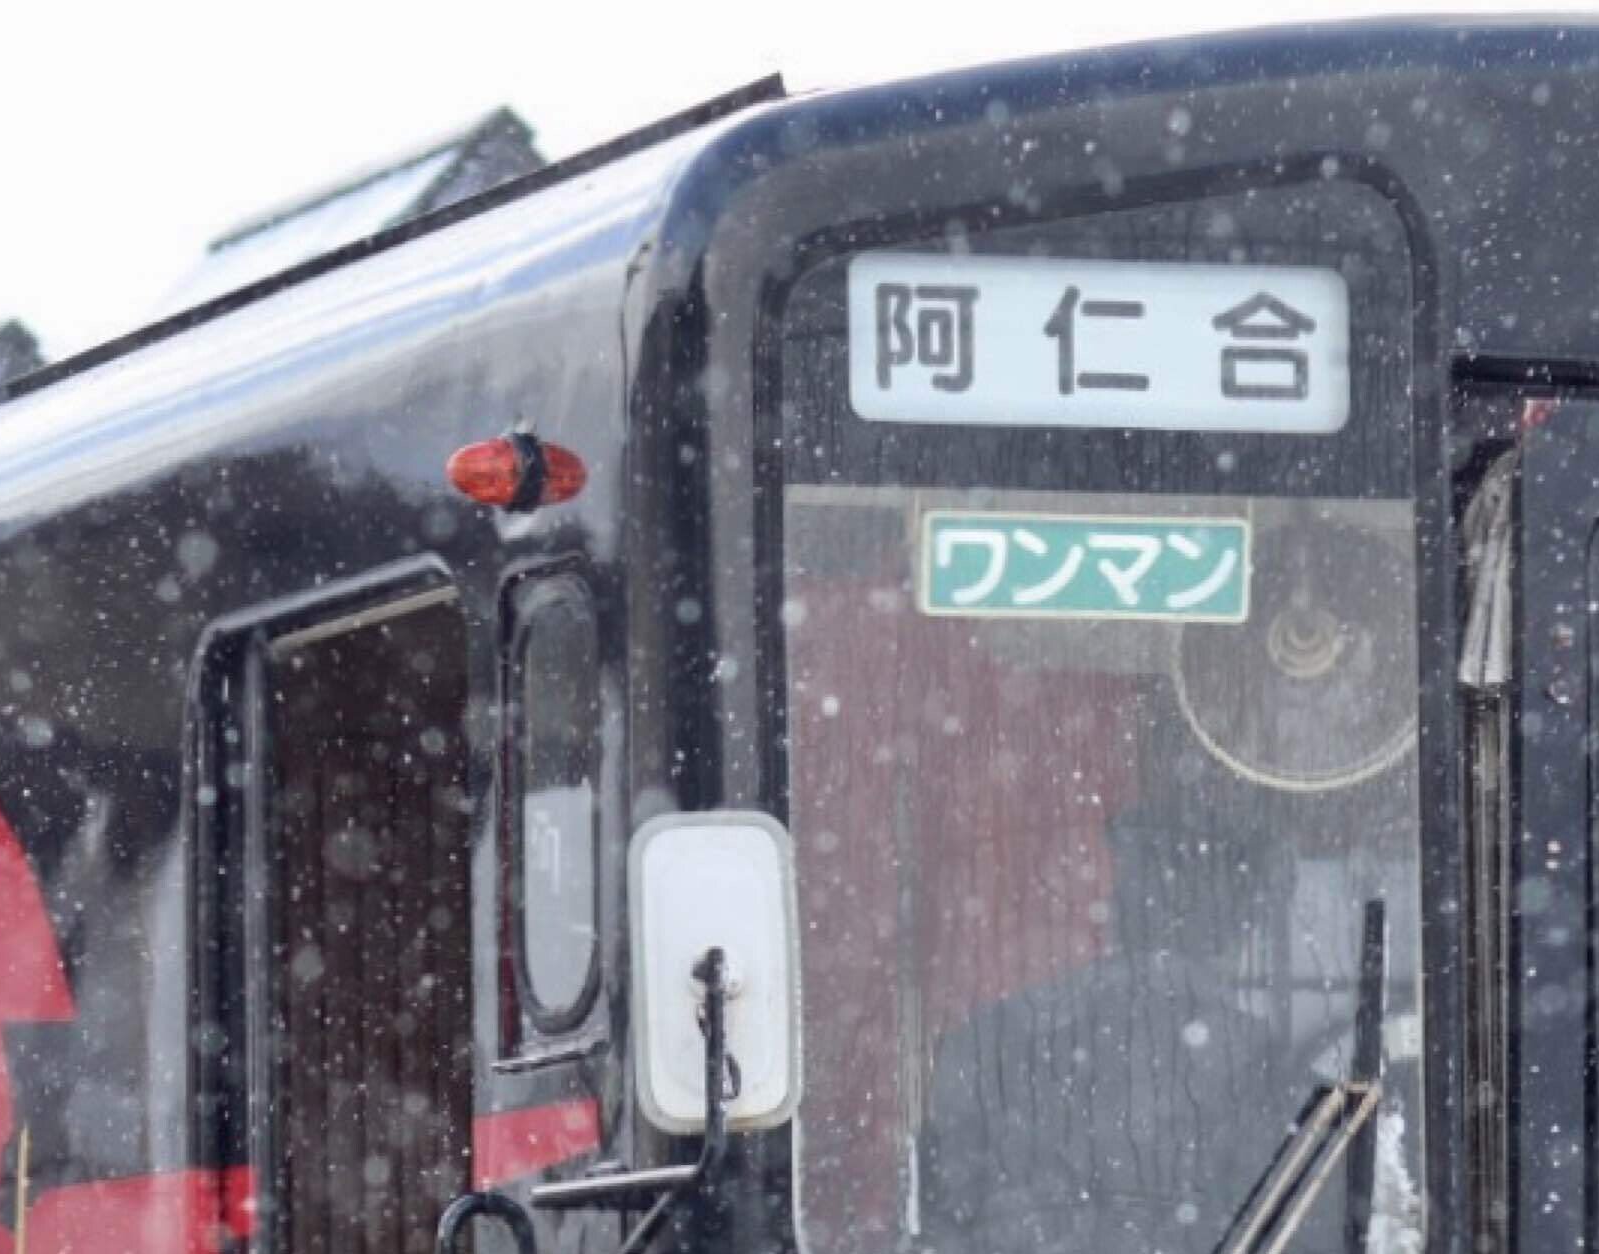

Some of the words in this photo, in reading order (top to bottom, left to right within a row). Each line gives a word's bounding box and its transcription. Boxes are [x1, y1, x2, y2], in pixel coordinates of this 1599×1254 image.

[874, 280, 1318, 401] 阿仁合
[935, 527, 1238, 607] ワンマン
